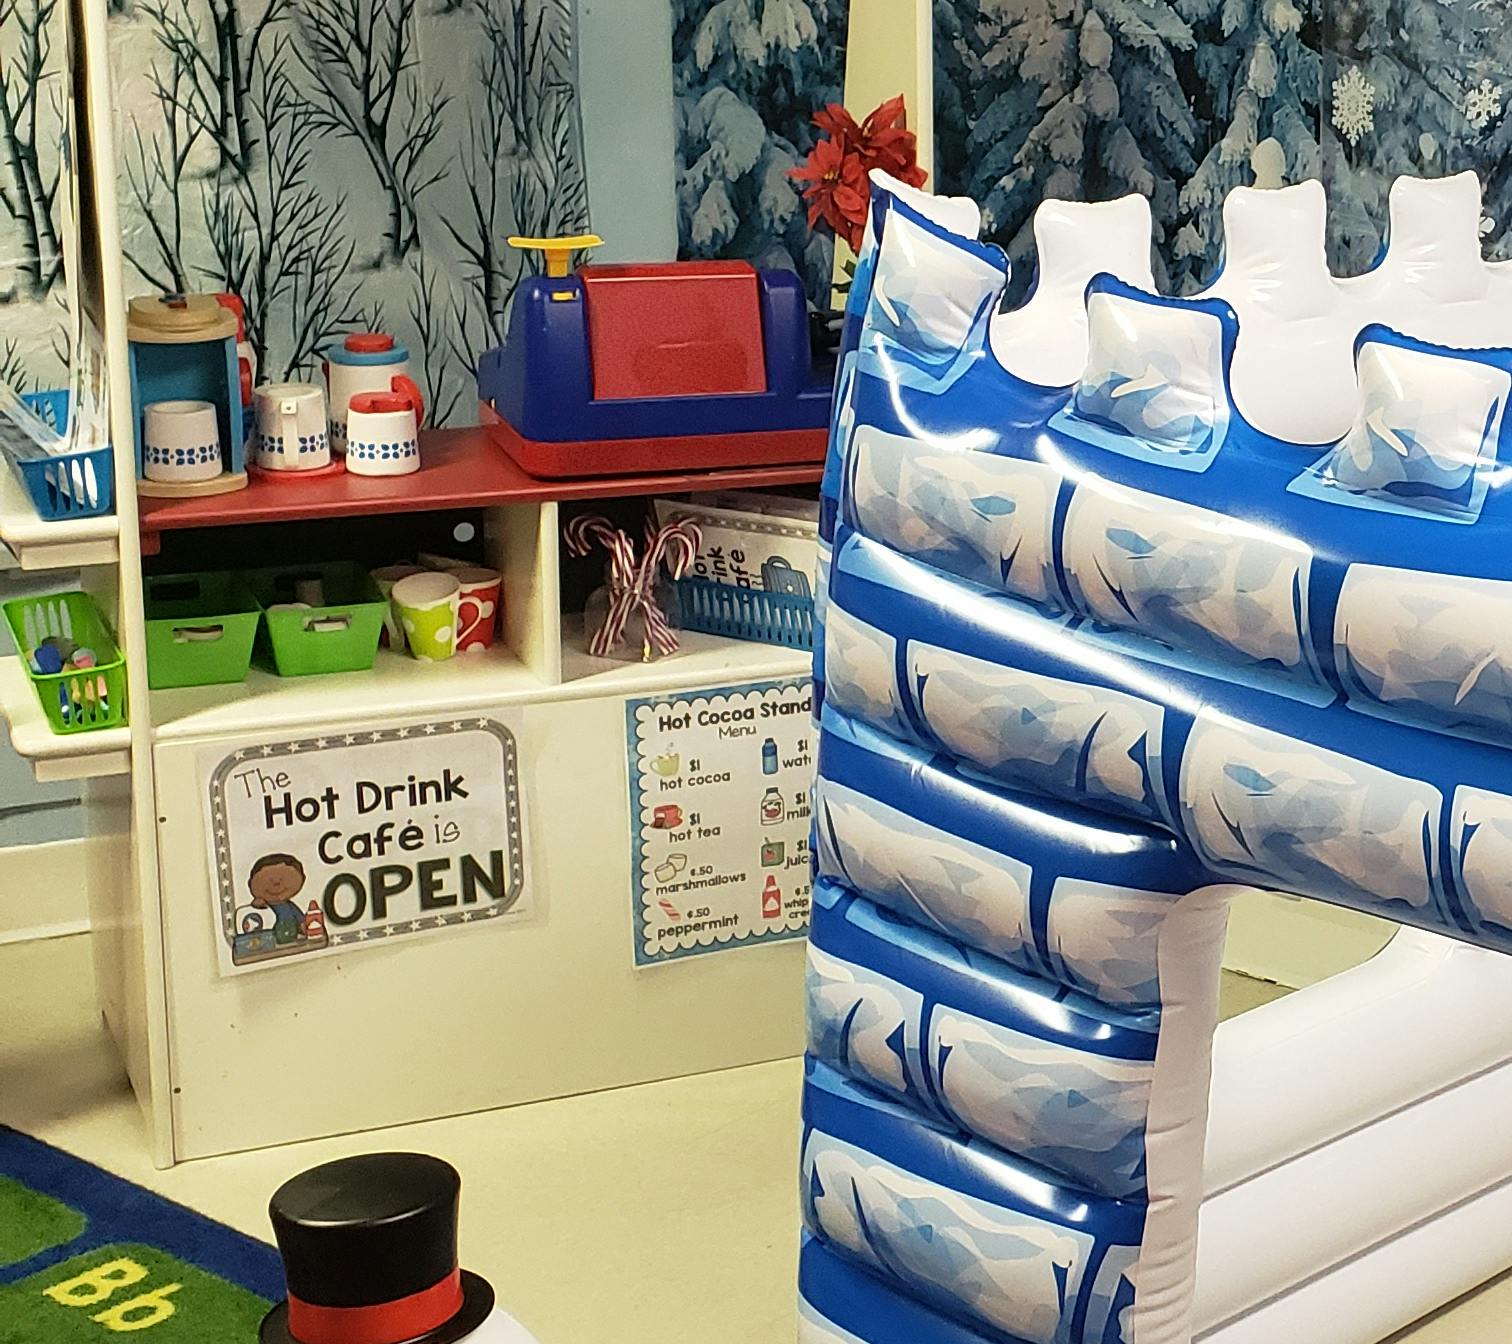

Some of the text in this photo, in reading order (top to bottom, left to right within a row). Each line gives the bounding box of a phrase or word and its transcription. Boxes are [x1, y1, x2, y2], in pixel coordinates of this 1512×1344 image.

[728, 549, 751, 589] afé
[658, 696, 812, 733] Hot Cocoa Stand
[718, 724, 757, 740] Menu
[797, 739, 808, 752] $1
[689, 759, 701, 772] $1
[782, 754, 811, 768] wat
[234, 767, 291, 798] The
[660, 771, 731, 791] hot cocoa
[264, 768, 469, 829] Hot Drink
[795, 792, 806, 805] $1
[689, 813, 700, 826] $1
[318, 814, 460, 865] Café is
[669, 825, 721, 843] hot tea
[796, 839, 807, 852] $1
[784, 855, 809, 870] juic
[323, 849, 507, 927] OPEN
[655, 872, 747, 896] marshmallows
[795, 885, 810, 896] ¢.5
[788, 909, 810, 919] cre
[657, 913, 740, 941] peppermint
[42, 1257, 184, 1332] Bb
